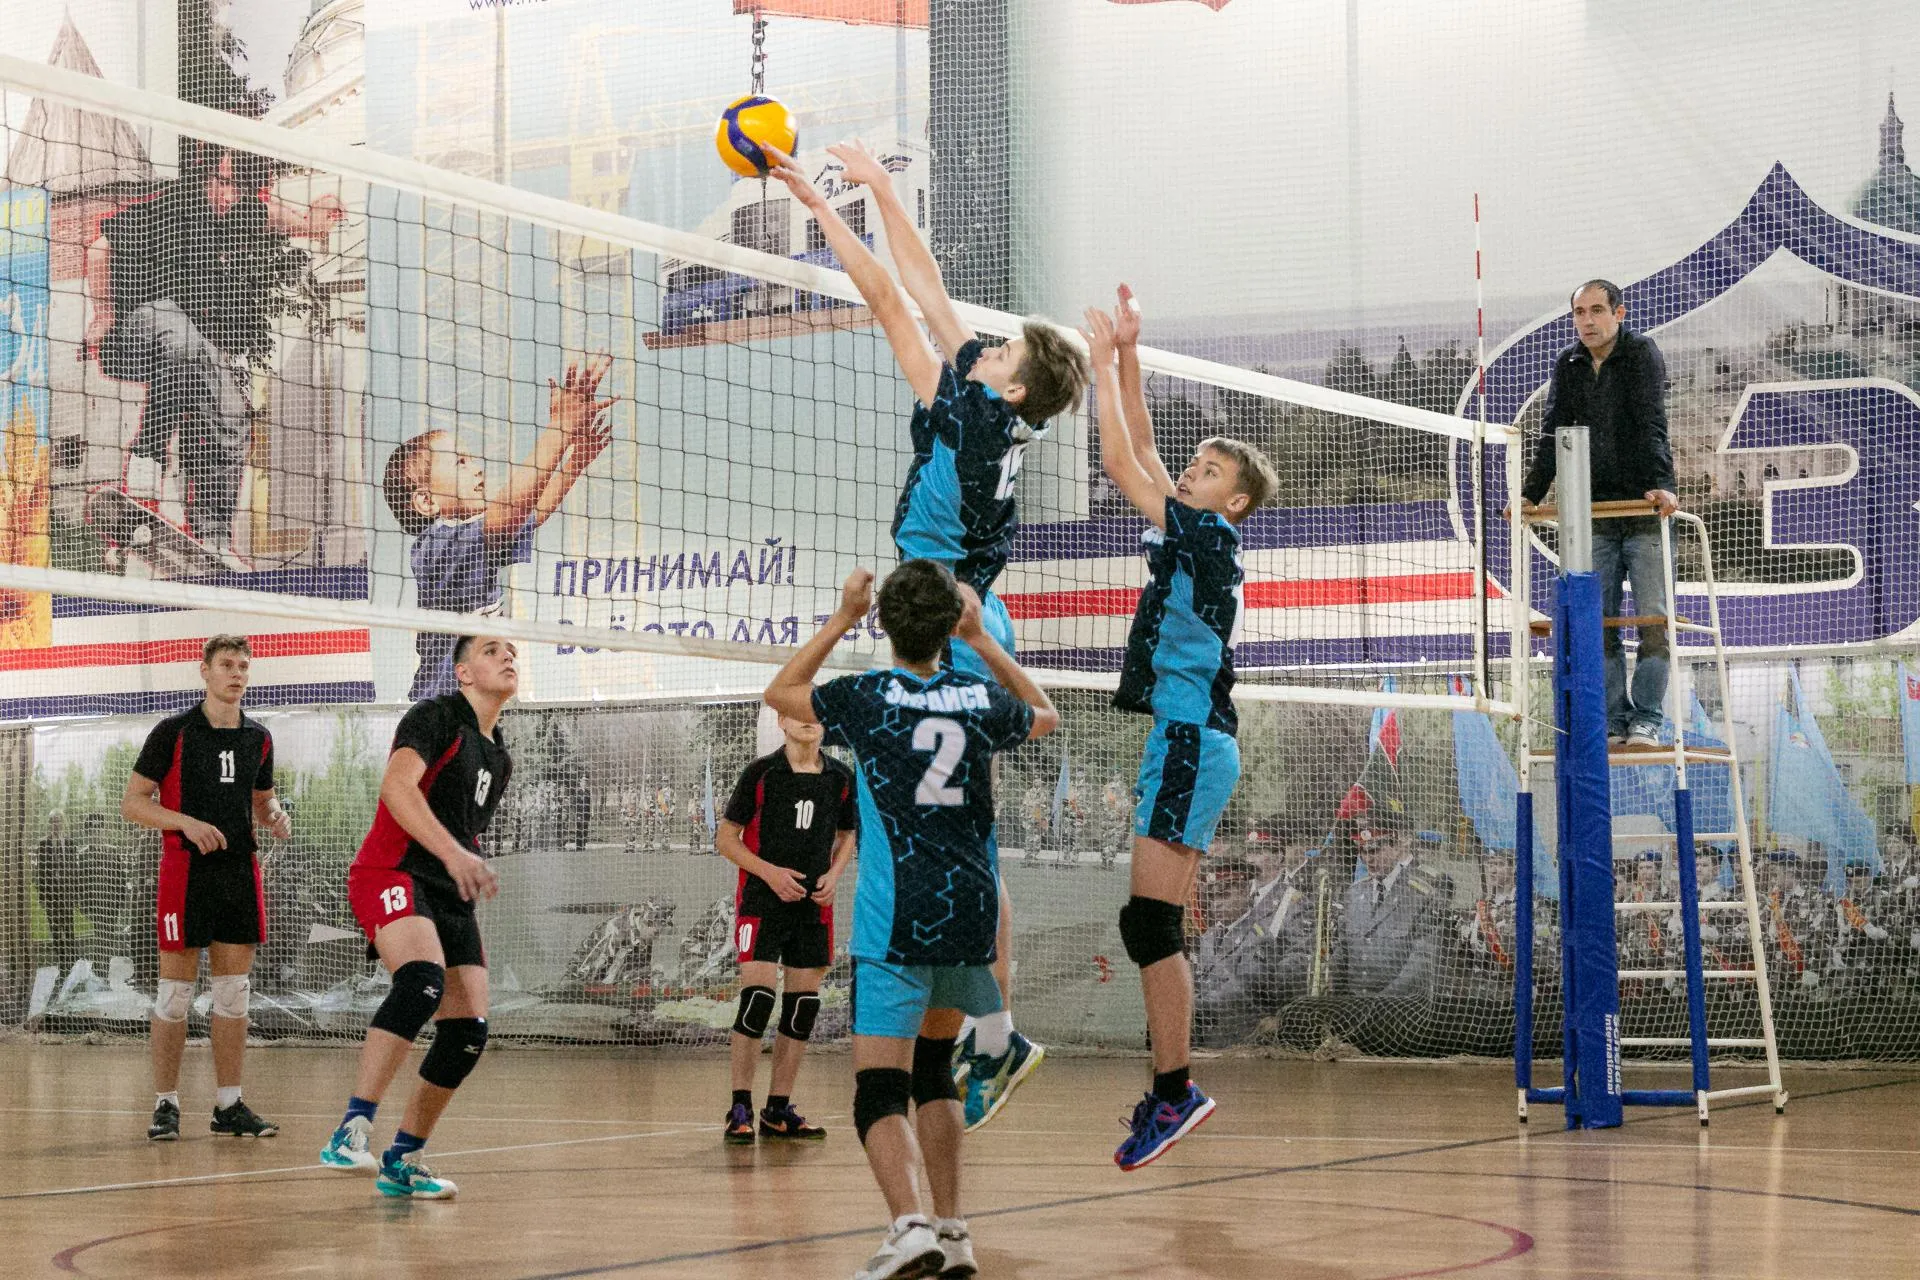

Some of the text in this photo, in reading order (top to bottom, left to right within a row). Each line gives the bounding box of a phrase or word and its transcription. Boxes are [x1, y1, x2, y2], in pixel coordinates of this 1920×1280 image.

[553, 537, 797, 597] ПРИНИМАЙ!
[218, 750, 235, 778] 11
[911, 717, 966, 805] 2
[474, 768, 493, 807] 13
[794, 799, 815, 830] 10
[379, 885, 408, 915] 13
[163, 912, 179, 941] 11
[738, 923, 753, 953] 10
